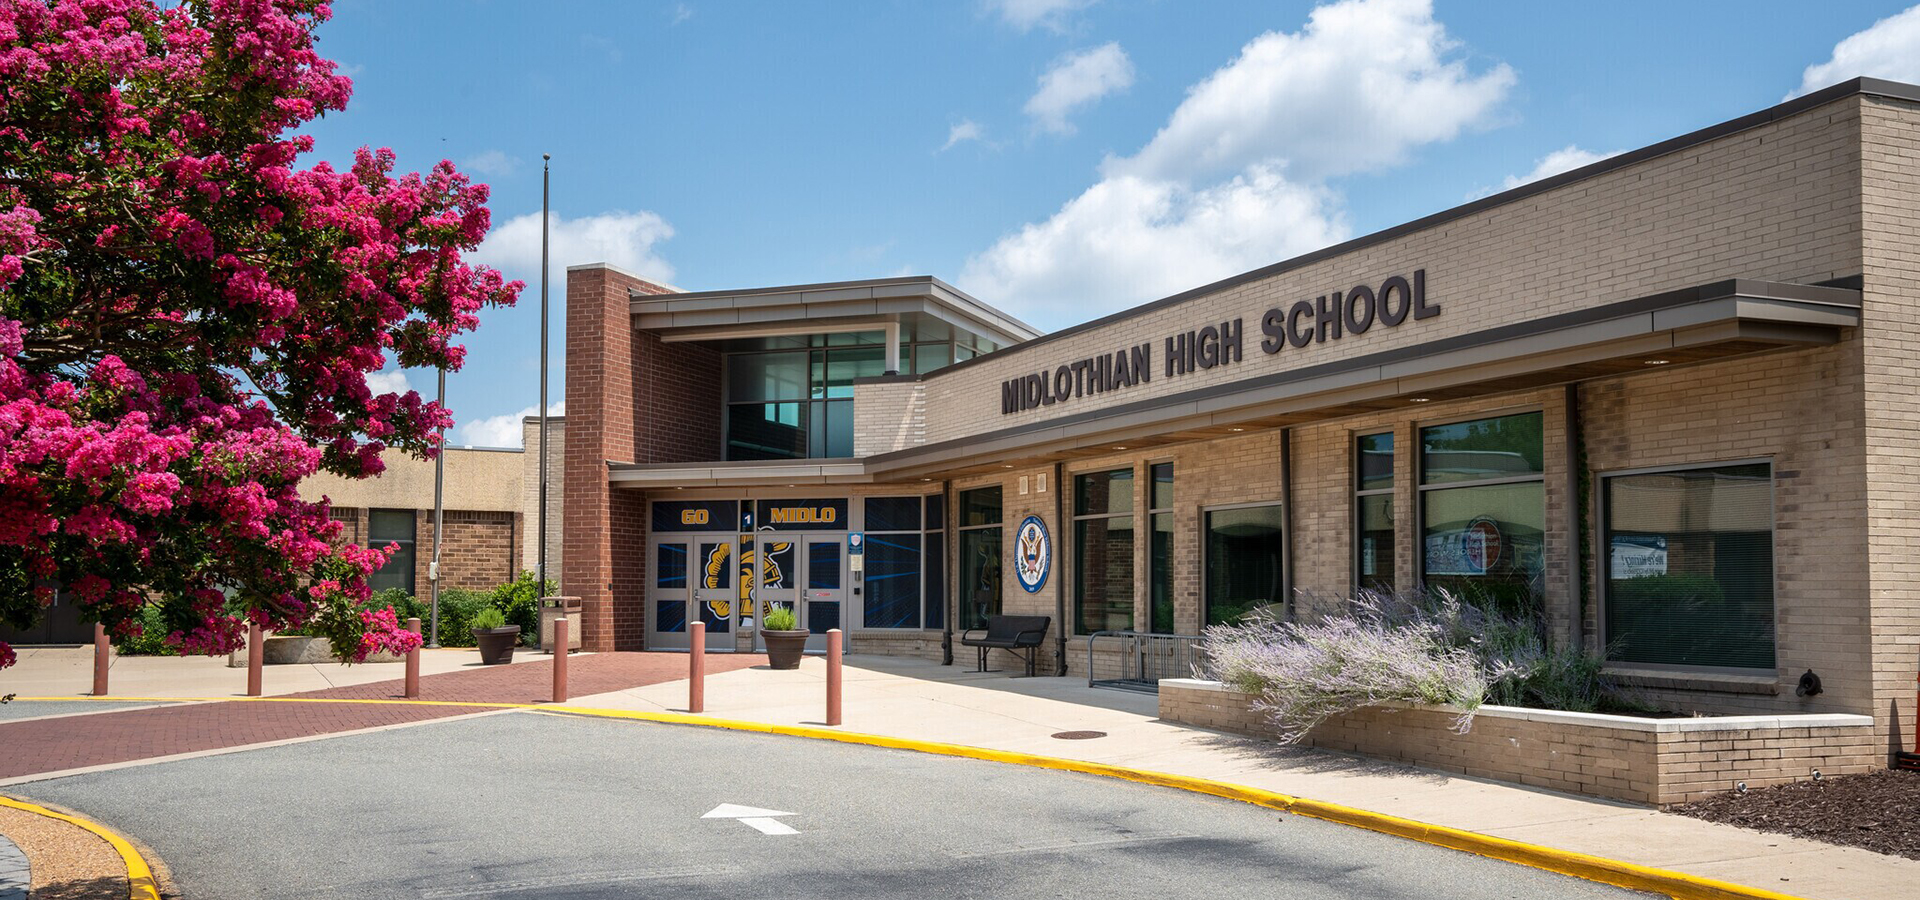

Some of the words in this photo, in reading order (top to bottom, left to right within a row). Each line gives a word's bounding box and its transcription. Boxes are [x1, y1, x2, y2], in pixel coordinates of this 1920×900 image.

[1001, 343, 1150, 414] MIDLOTHIAN
[1165, 318, 1242, 377] HIGH
[1261, 269, 1441, 354] SCHOOL
[681, 509, 709, 525] GO
[744, 515, 751, 524] 1
[770, 507, 836, 523] MIDLO
